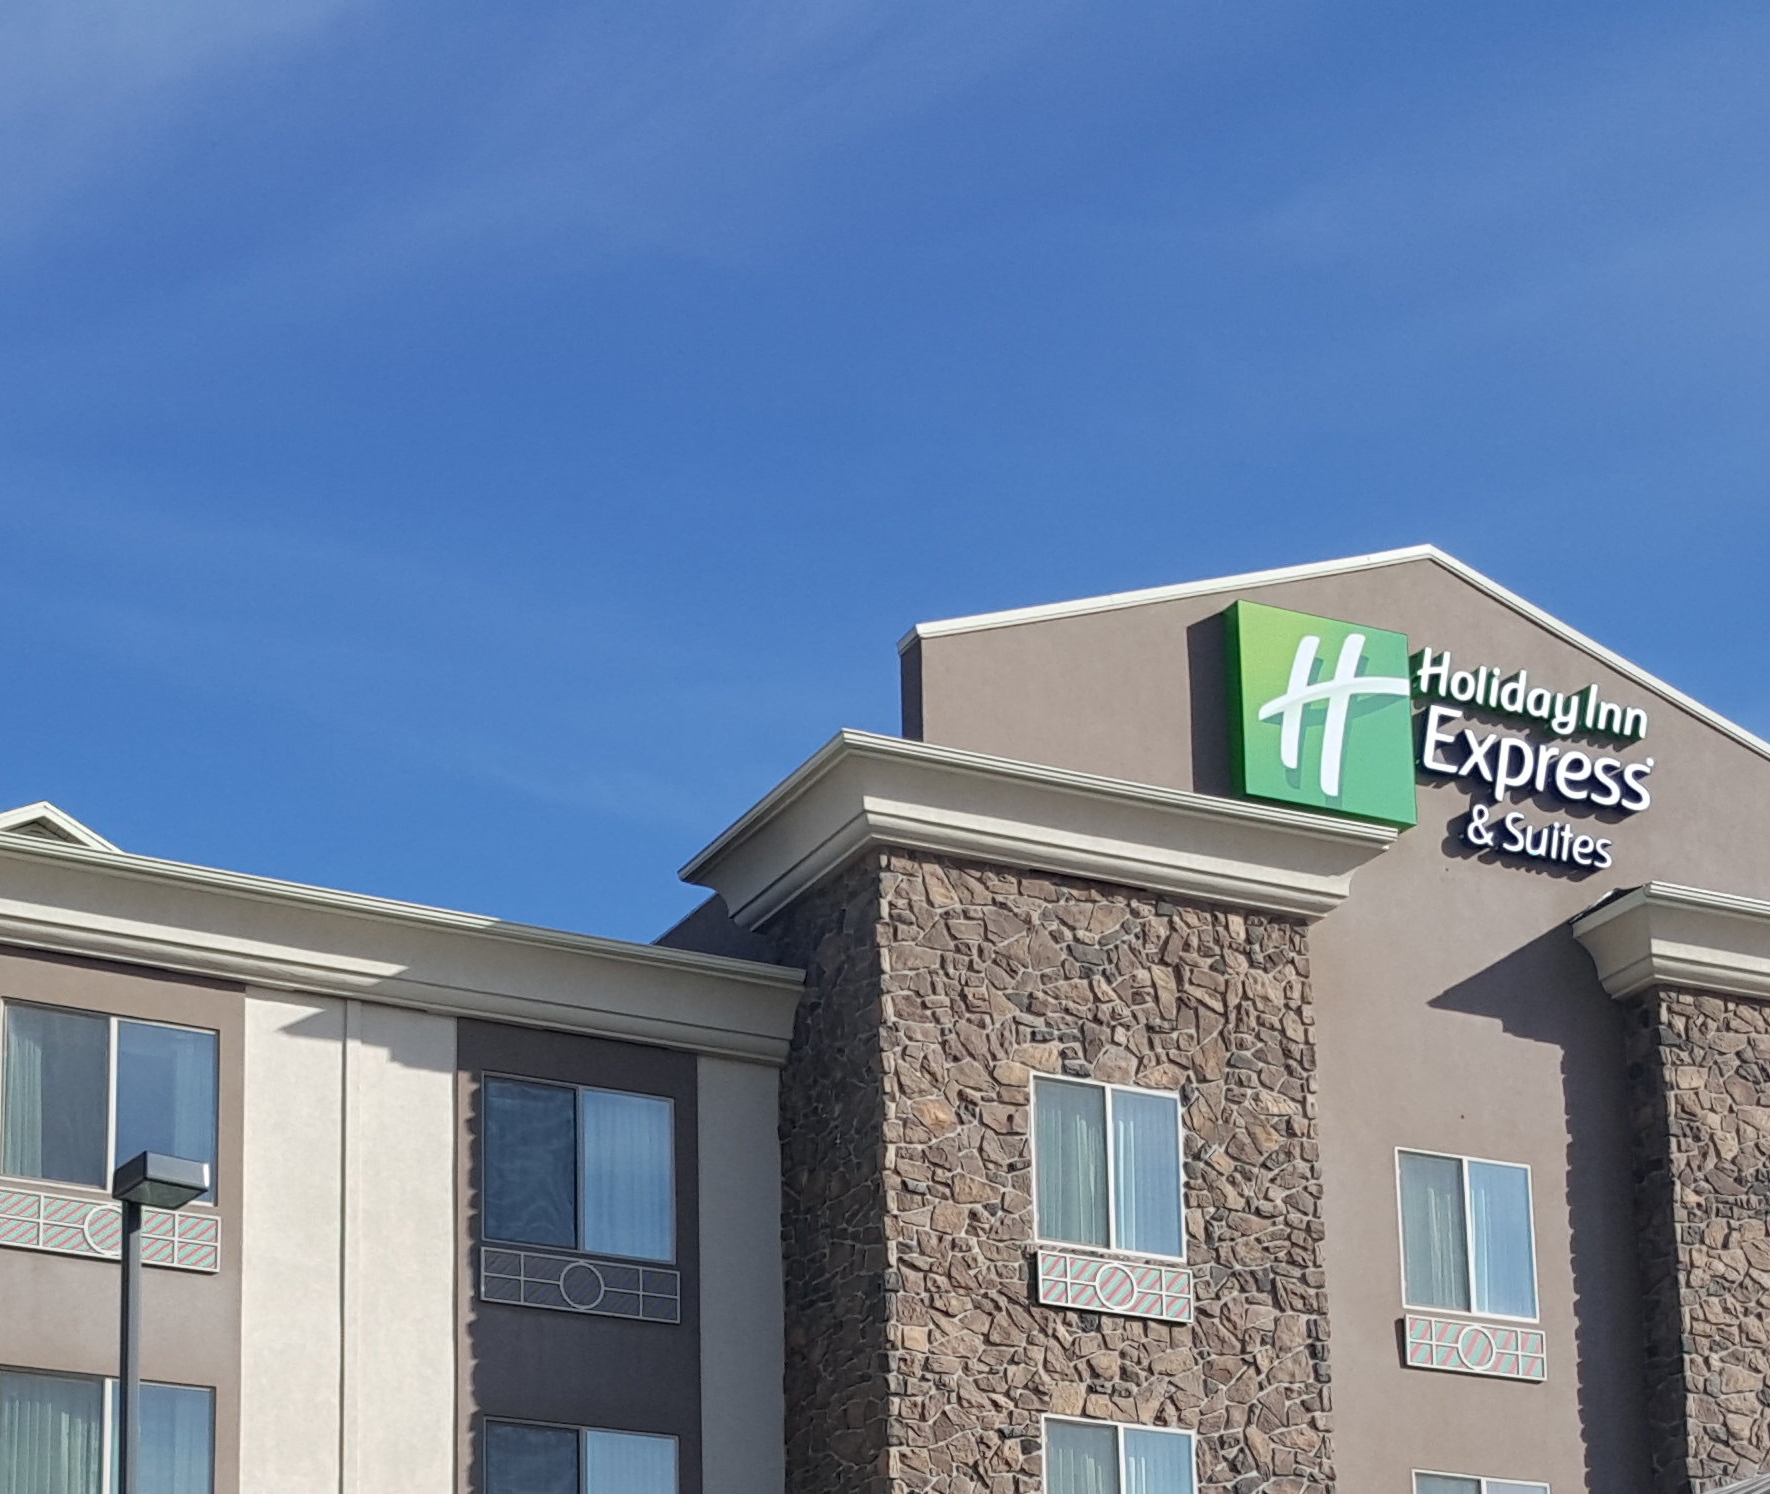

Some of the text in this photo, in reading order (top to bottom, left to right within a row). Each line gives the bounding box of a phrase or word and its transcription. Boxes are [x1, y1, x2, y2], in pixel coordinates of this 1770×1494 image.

[1416, 647, 1648, 739] Holiday Inn
[1423, 704, 1652, 811] Express
[1467, 804, 1613, 868] & Suites
